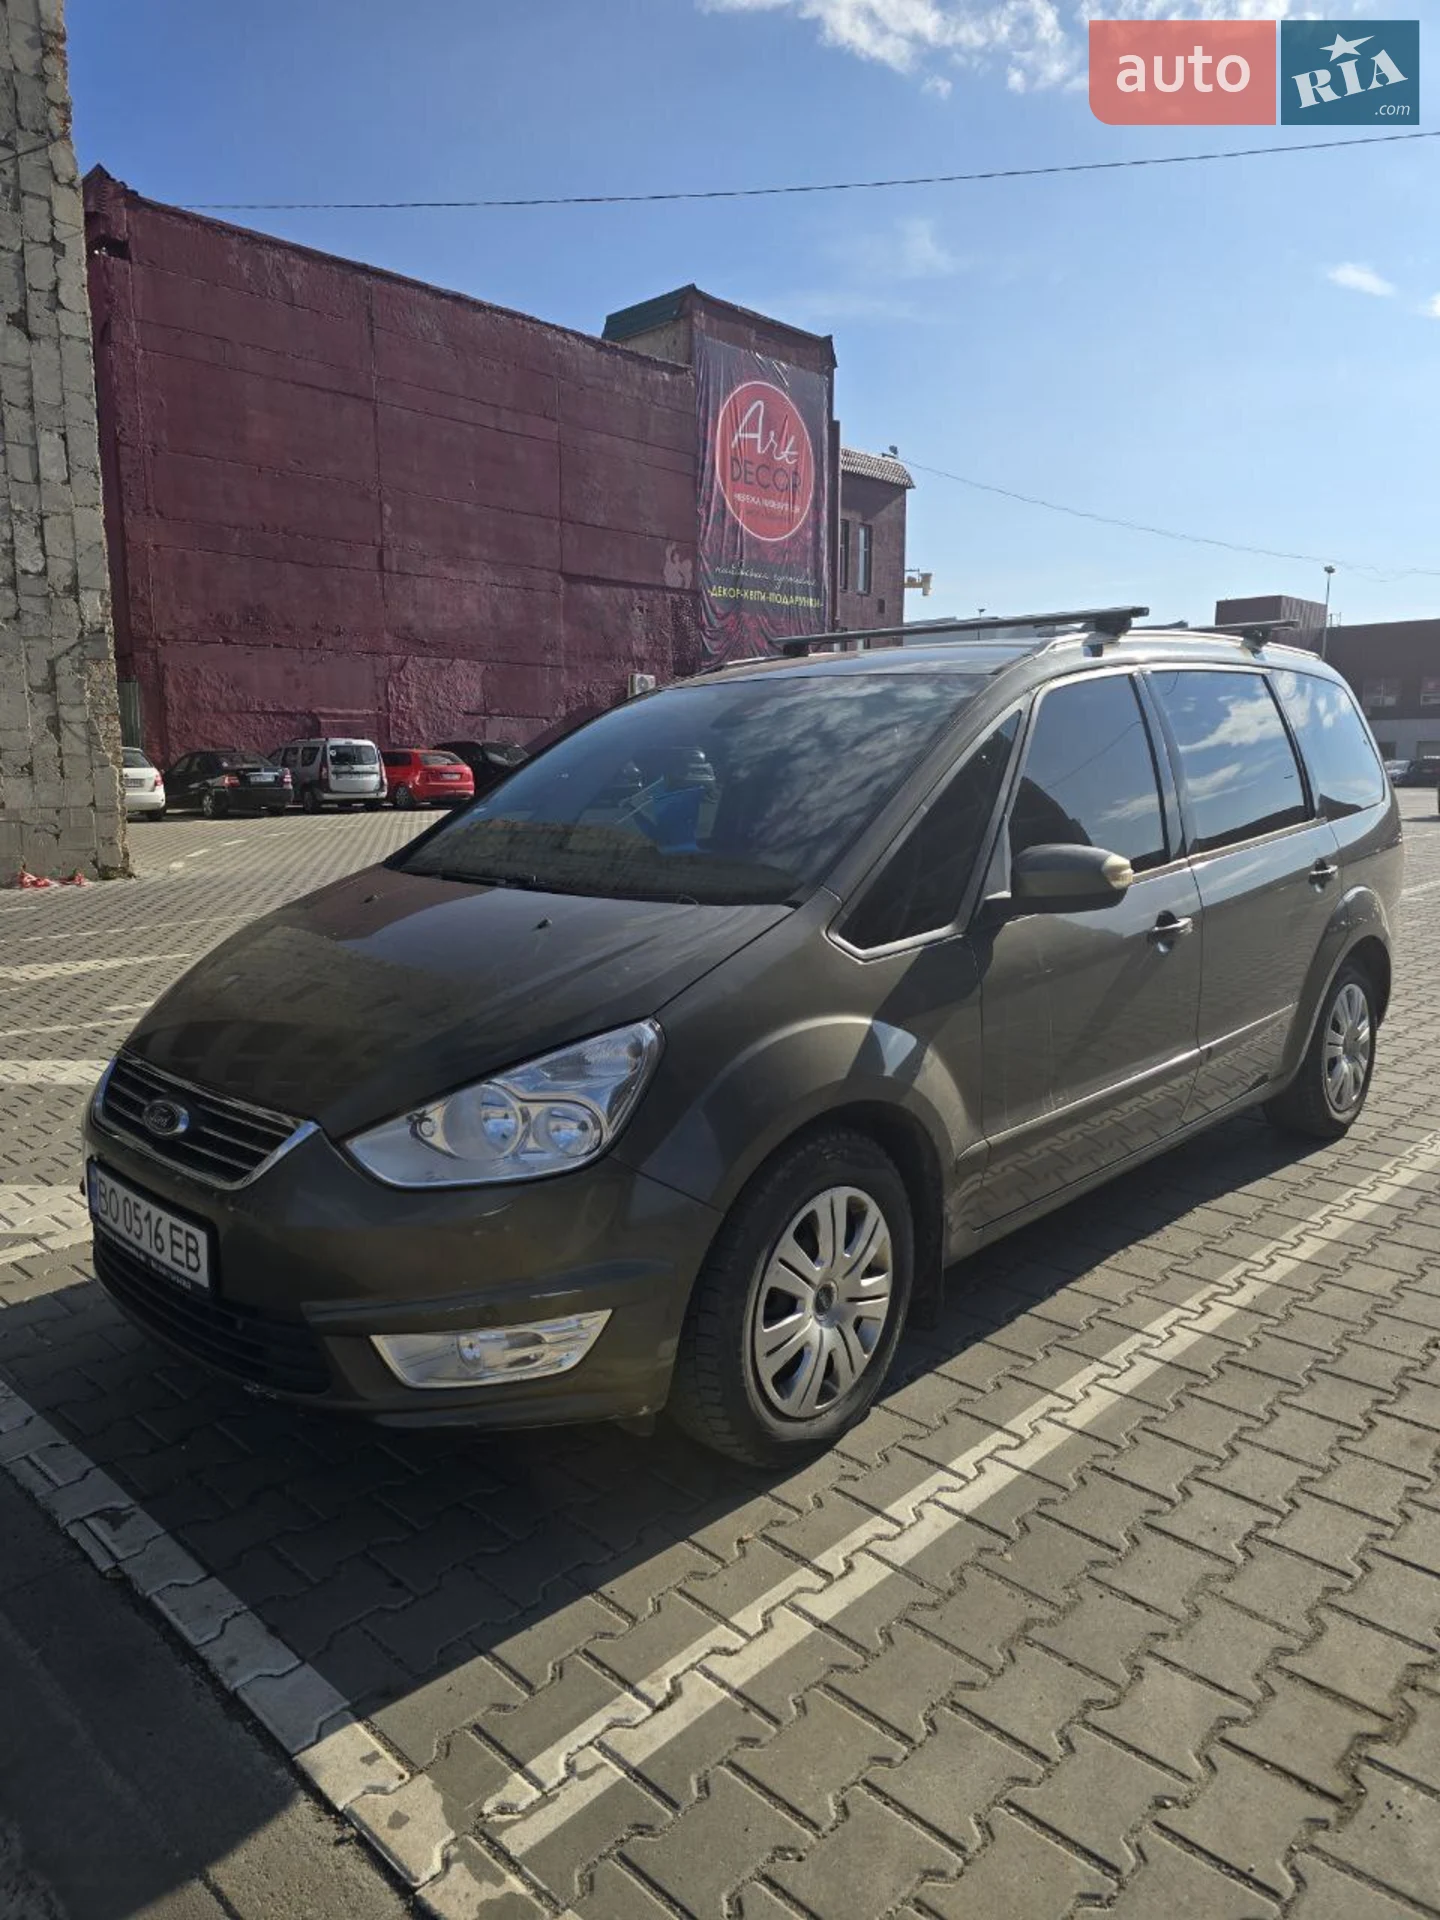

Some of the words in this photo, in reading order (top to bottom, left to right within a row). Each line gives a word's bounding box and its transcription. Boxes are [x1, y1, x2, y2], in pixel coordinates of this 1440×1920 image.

[731, 400, 799, 465] Art
[730, 456, 802, 493] DECOR
[122, 1196, 165, 1254] 0516
[169, 1220, 201, 1273] EB
